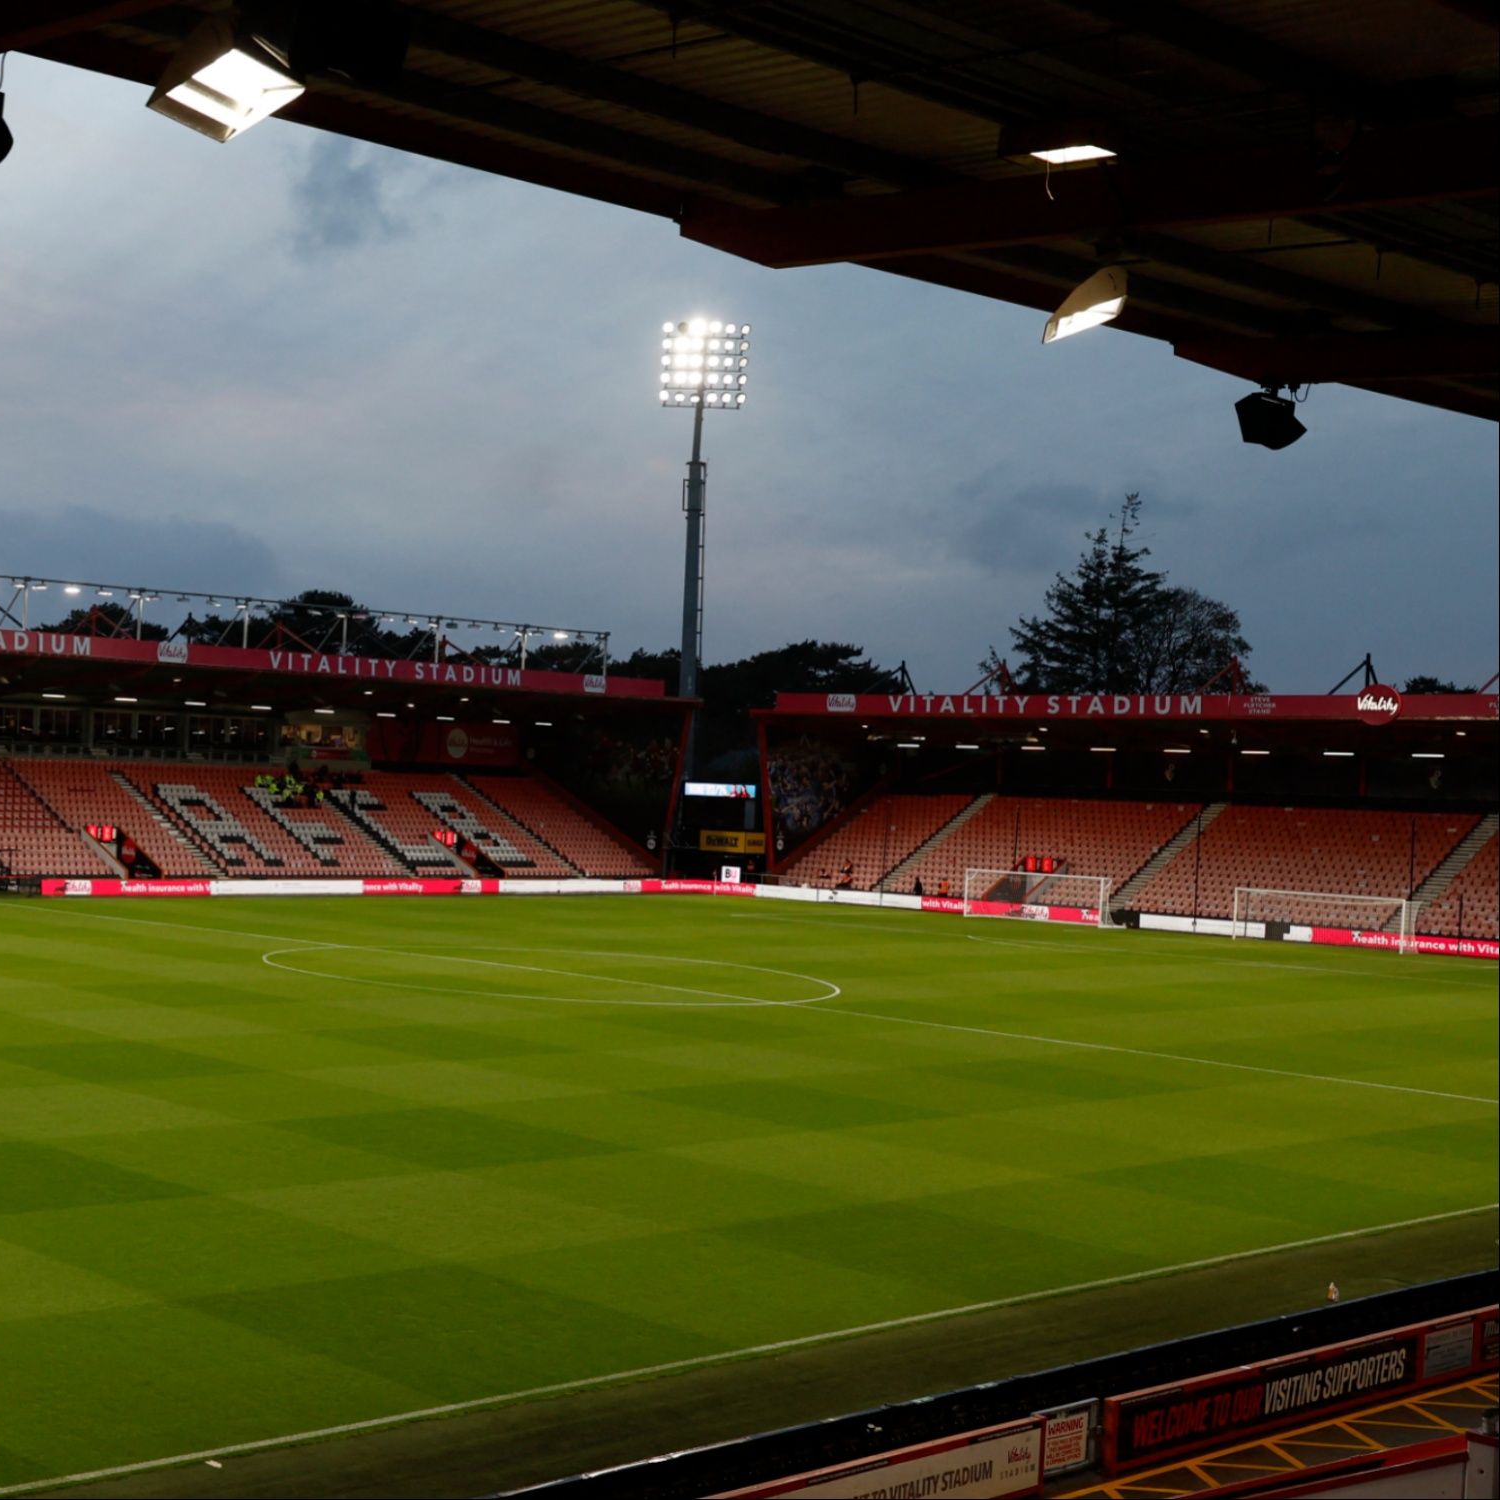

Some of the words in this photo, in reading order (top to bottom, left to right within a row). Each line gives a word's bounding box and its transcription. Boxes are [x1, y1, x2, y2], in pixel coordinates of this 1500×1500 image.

[269, 650, 398, 678] VITALITY
[415, 662, 522, 687] STADIUM
[889, 695, 1029, 713] VITALITY
[1047, 695, 1202, 715] STADIUM
[1356, 693, 1398, 716] Vitality
[148, 881, 186, 893] insurance
[187, 881, 205, 893] with
[382, 882, 399, 893] with
[399, 882, 424, 895] Vitality
[922, 898, 941, 908] with
[1449, 942, 1475, 954] with
[1133, 1399, 1211, 1448] WELCOME
[1210, 1394, 1232, 1427] TO
[1232, 1384, 1264, 1423] OUR
[1263, 1373, 1322, 1415] VISITING
[1322, 1348, 1406, 1399] SUPPORTERS
[1048, 1416, 1084, 1436] WARNING
[941, 1460, 993, 1491] STADIUM
